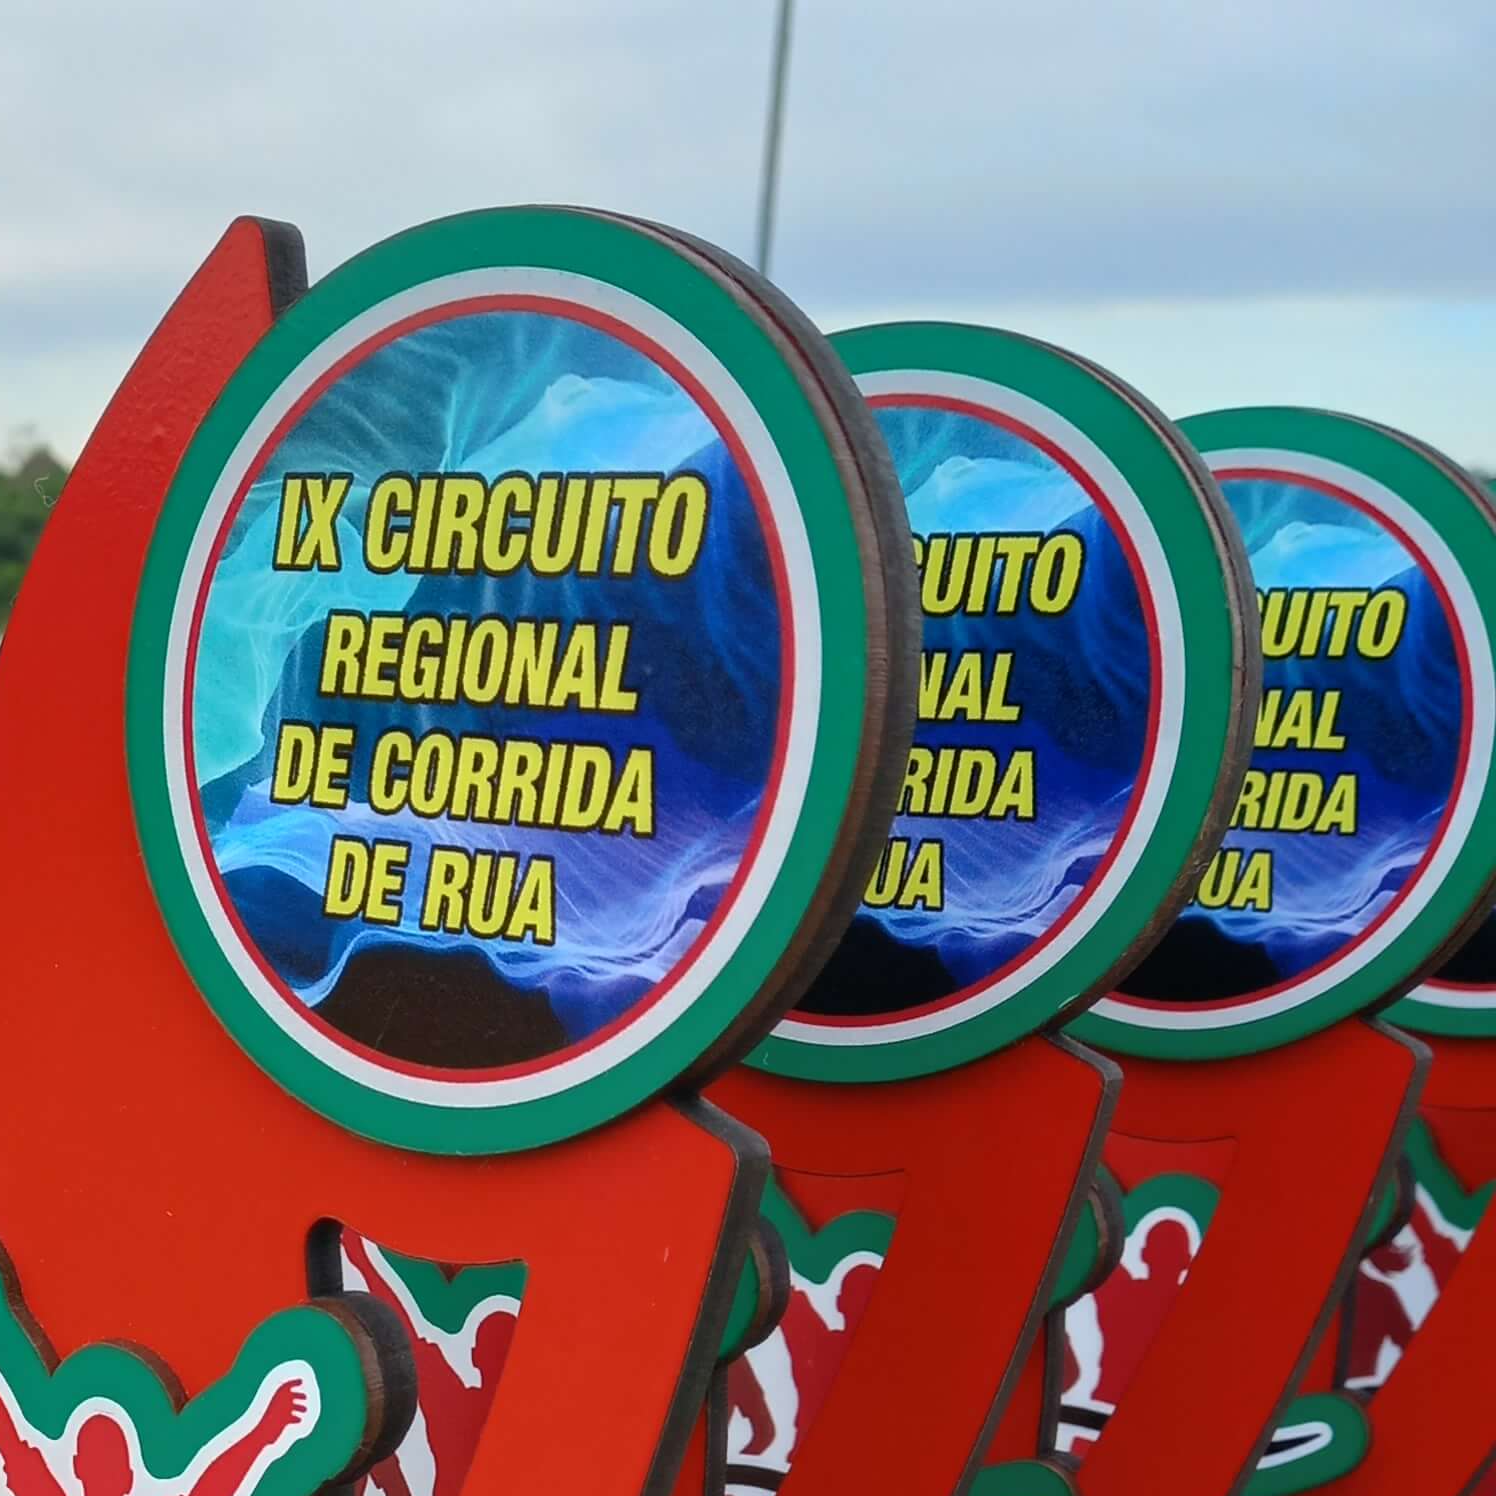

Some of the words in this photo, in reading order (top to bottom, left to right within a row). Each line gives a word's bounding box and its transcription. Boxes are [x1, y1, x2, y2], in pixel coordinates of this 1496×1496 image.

[272, 473, 347, 571] IX
[361, 473, 710, 579] CIRCUITO
[912, 530, 1085, 617] UITO
[320, 612, 639, 713] REGIONAL
[1256, 587, 1408, 662] UITO
[271, 722, 355, 810] DE
[369, 729, 655, 838] CORRIDA
[323, 836, 410, 926] DE
[420, 843, 556, 945] RUA
